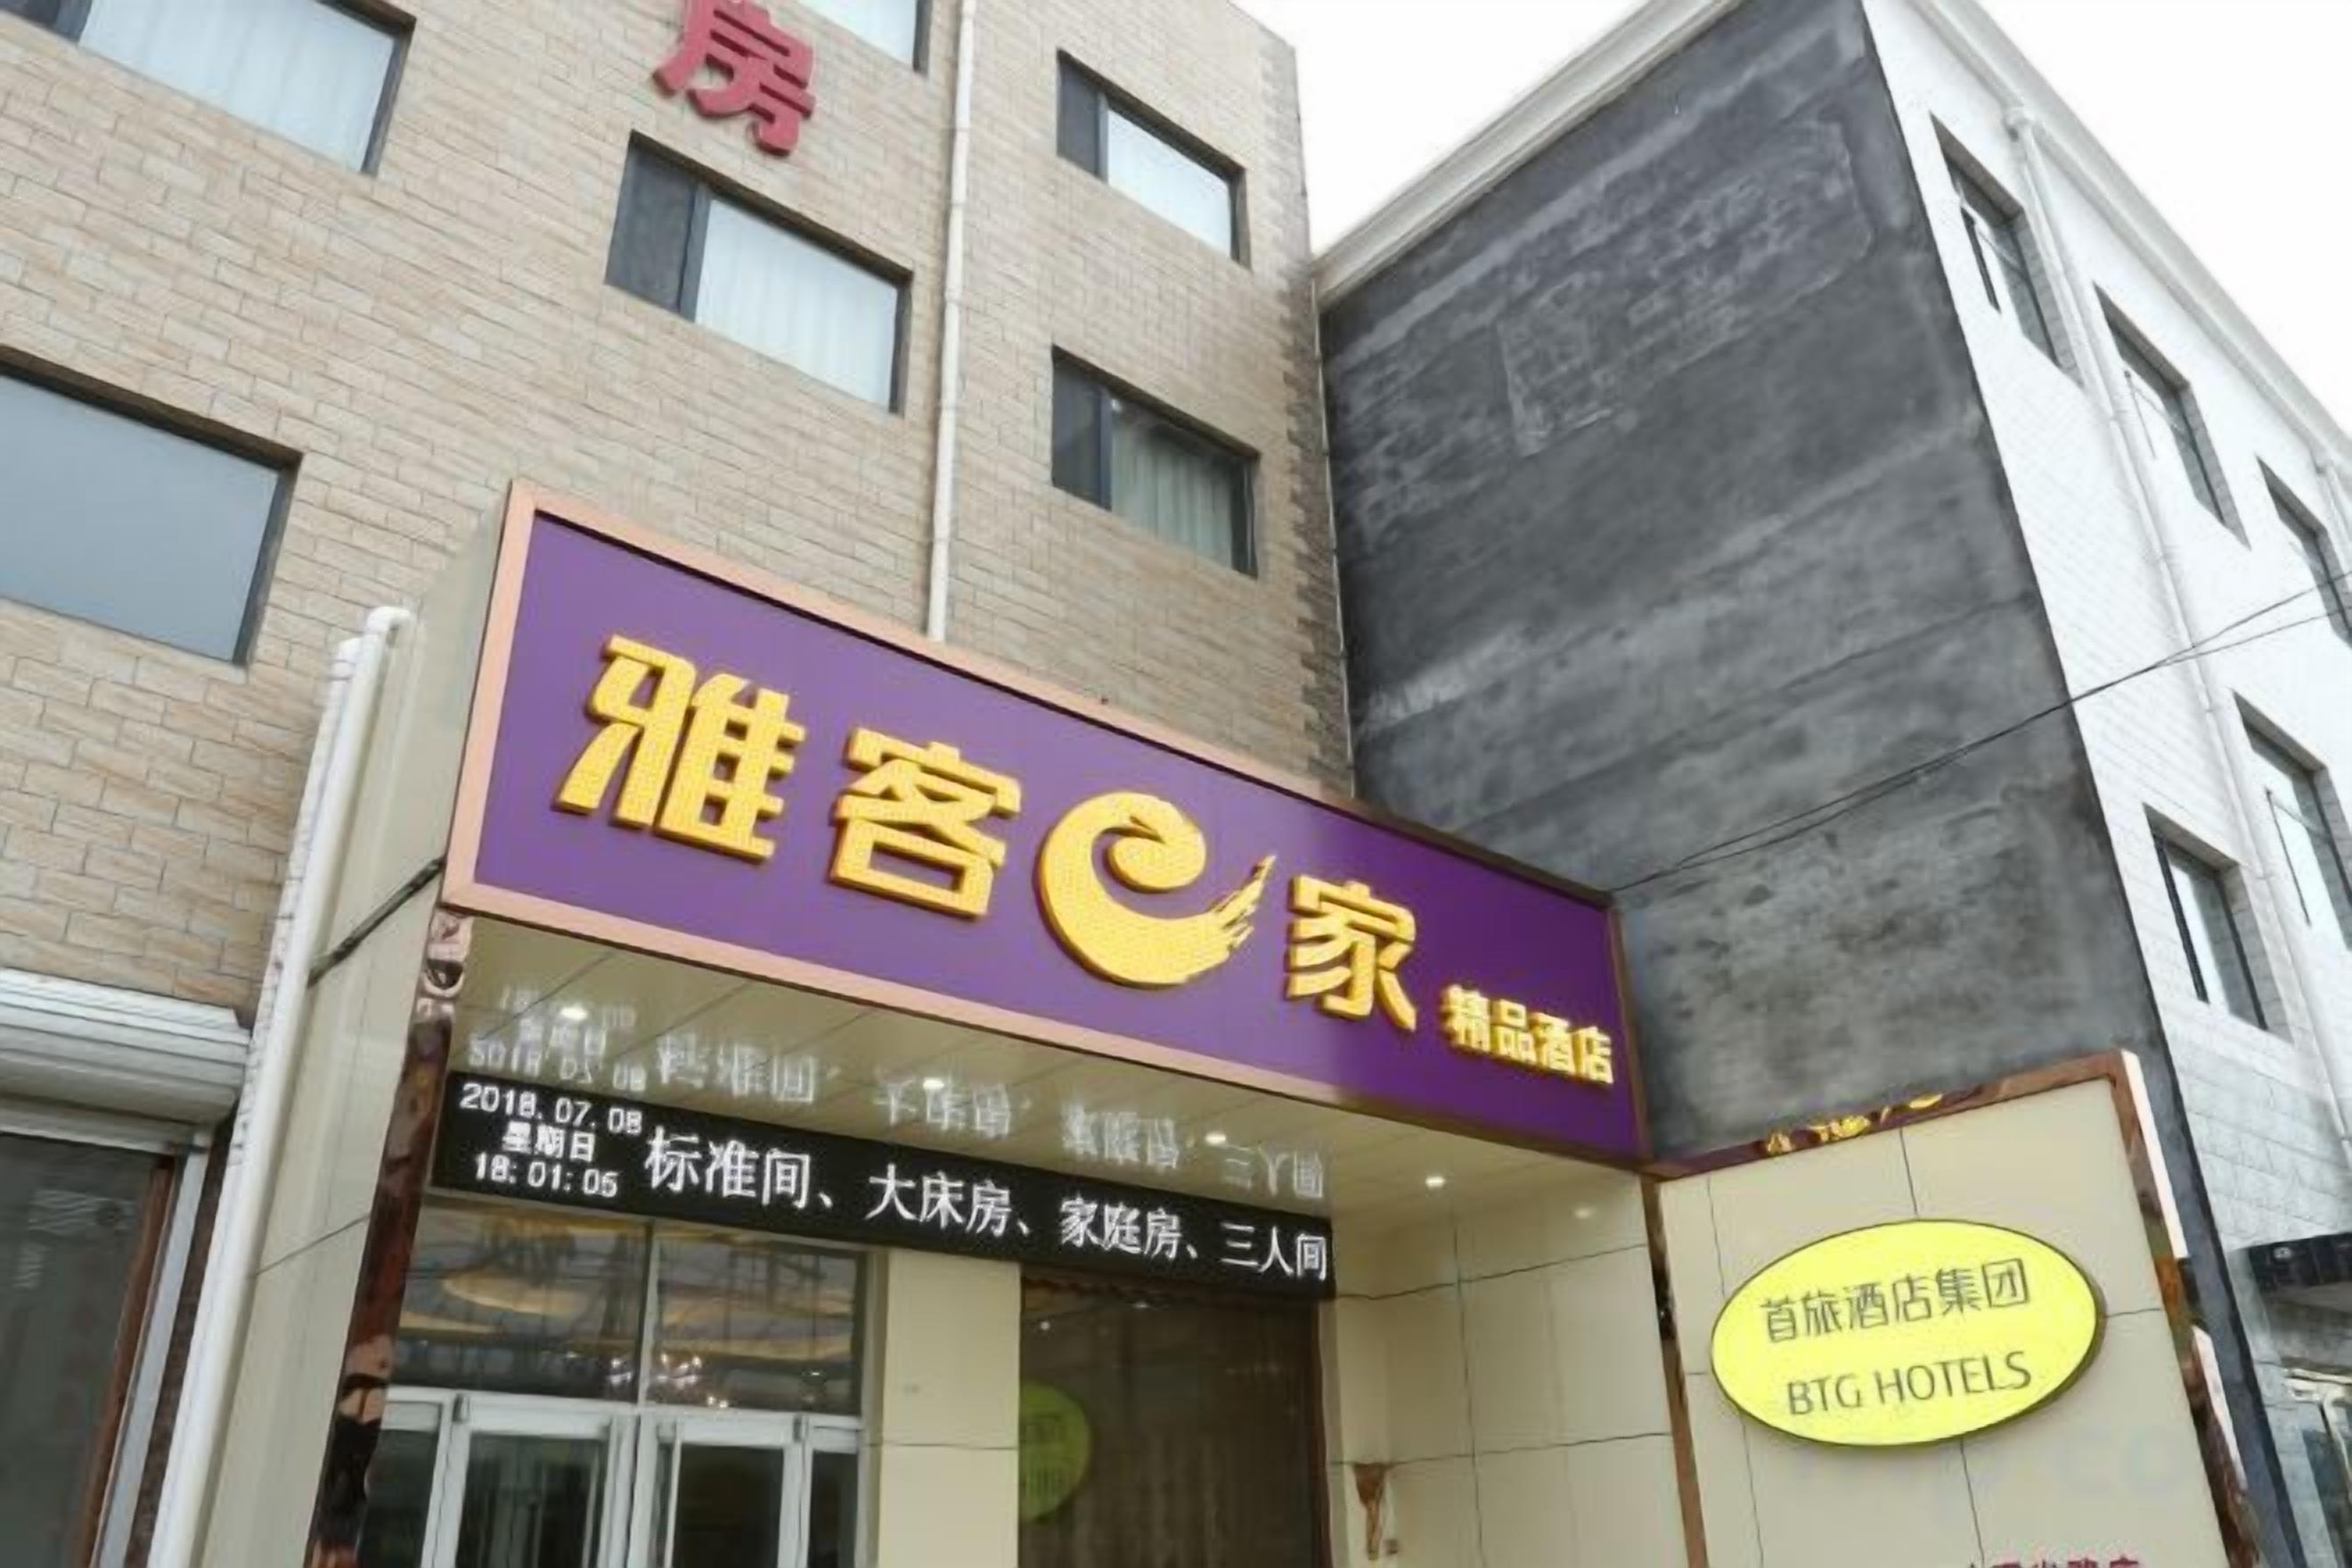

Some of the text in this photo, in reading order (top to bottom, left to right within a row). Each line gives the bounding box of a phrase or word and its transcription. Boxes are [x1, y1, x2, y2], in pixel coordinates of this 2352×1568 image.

[652, 0, 815, 157] 房
[1441, 984, 1614, 1085] 精品酒店
[501, 1120, 595, 1164] 星期日
[1760, 1257, 2030, 1343] 首旅酒店集团
[1787, 1350, 2032, 1416] BTG HOTELS
